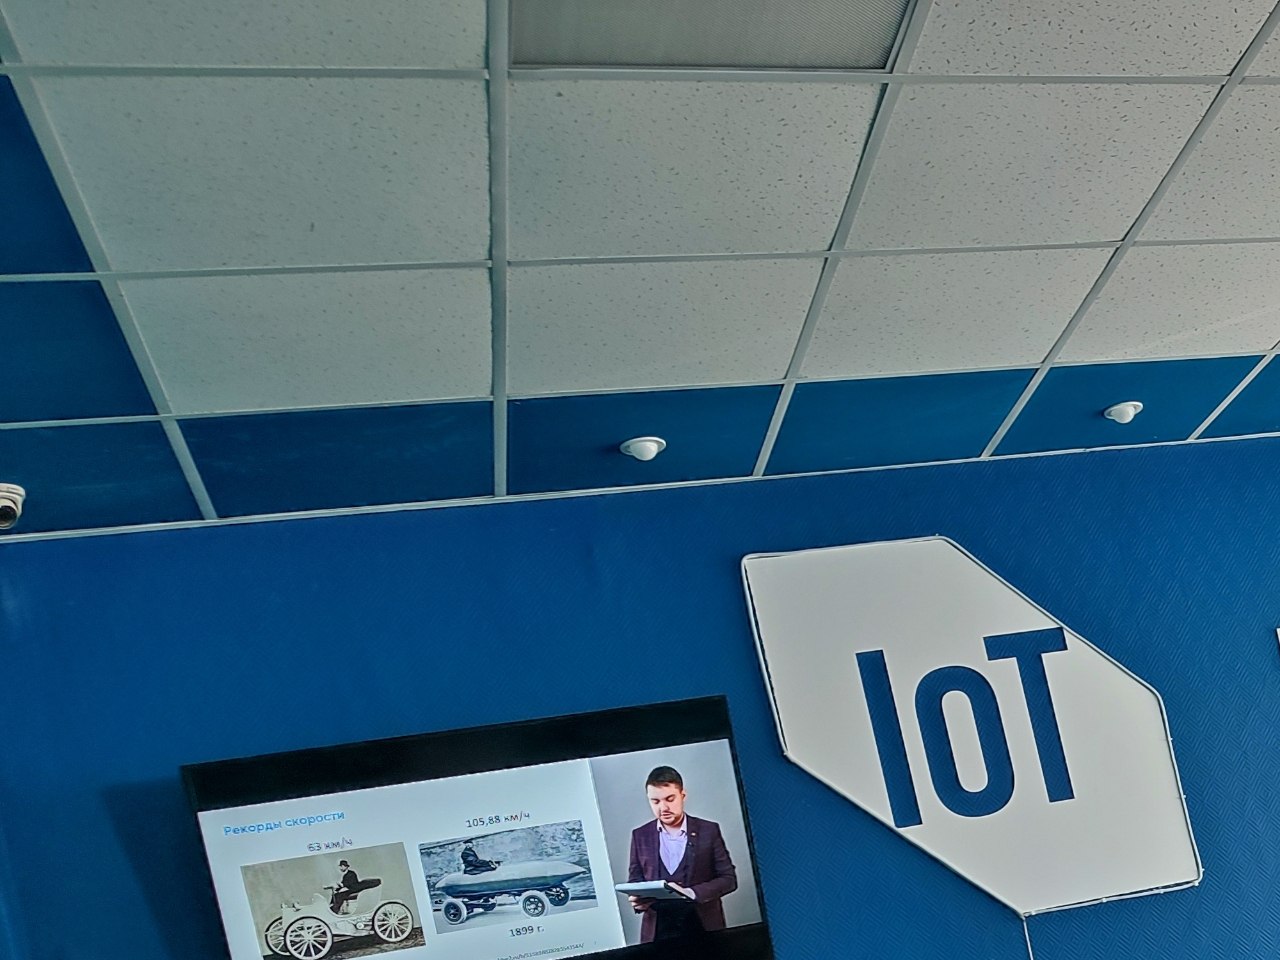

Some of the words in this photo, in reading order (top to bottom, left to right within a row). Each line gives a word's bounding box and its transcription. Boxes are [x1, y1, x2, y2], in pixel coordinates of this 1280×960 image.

[223, 821, 282, 835] Рекорды
[285, 811, 345, 826] скорости
[465, 815, 501, 828] 105,88
[504, 811, 530, 822] км/ч
[307, 842, 322, 852] 63
[324, 837, 353, 850] км/ч
[509, 925, 534, 937] 1899
